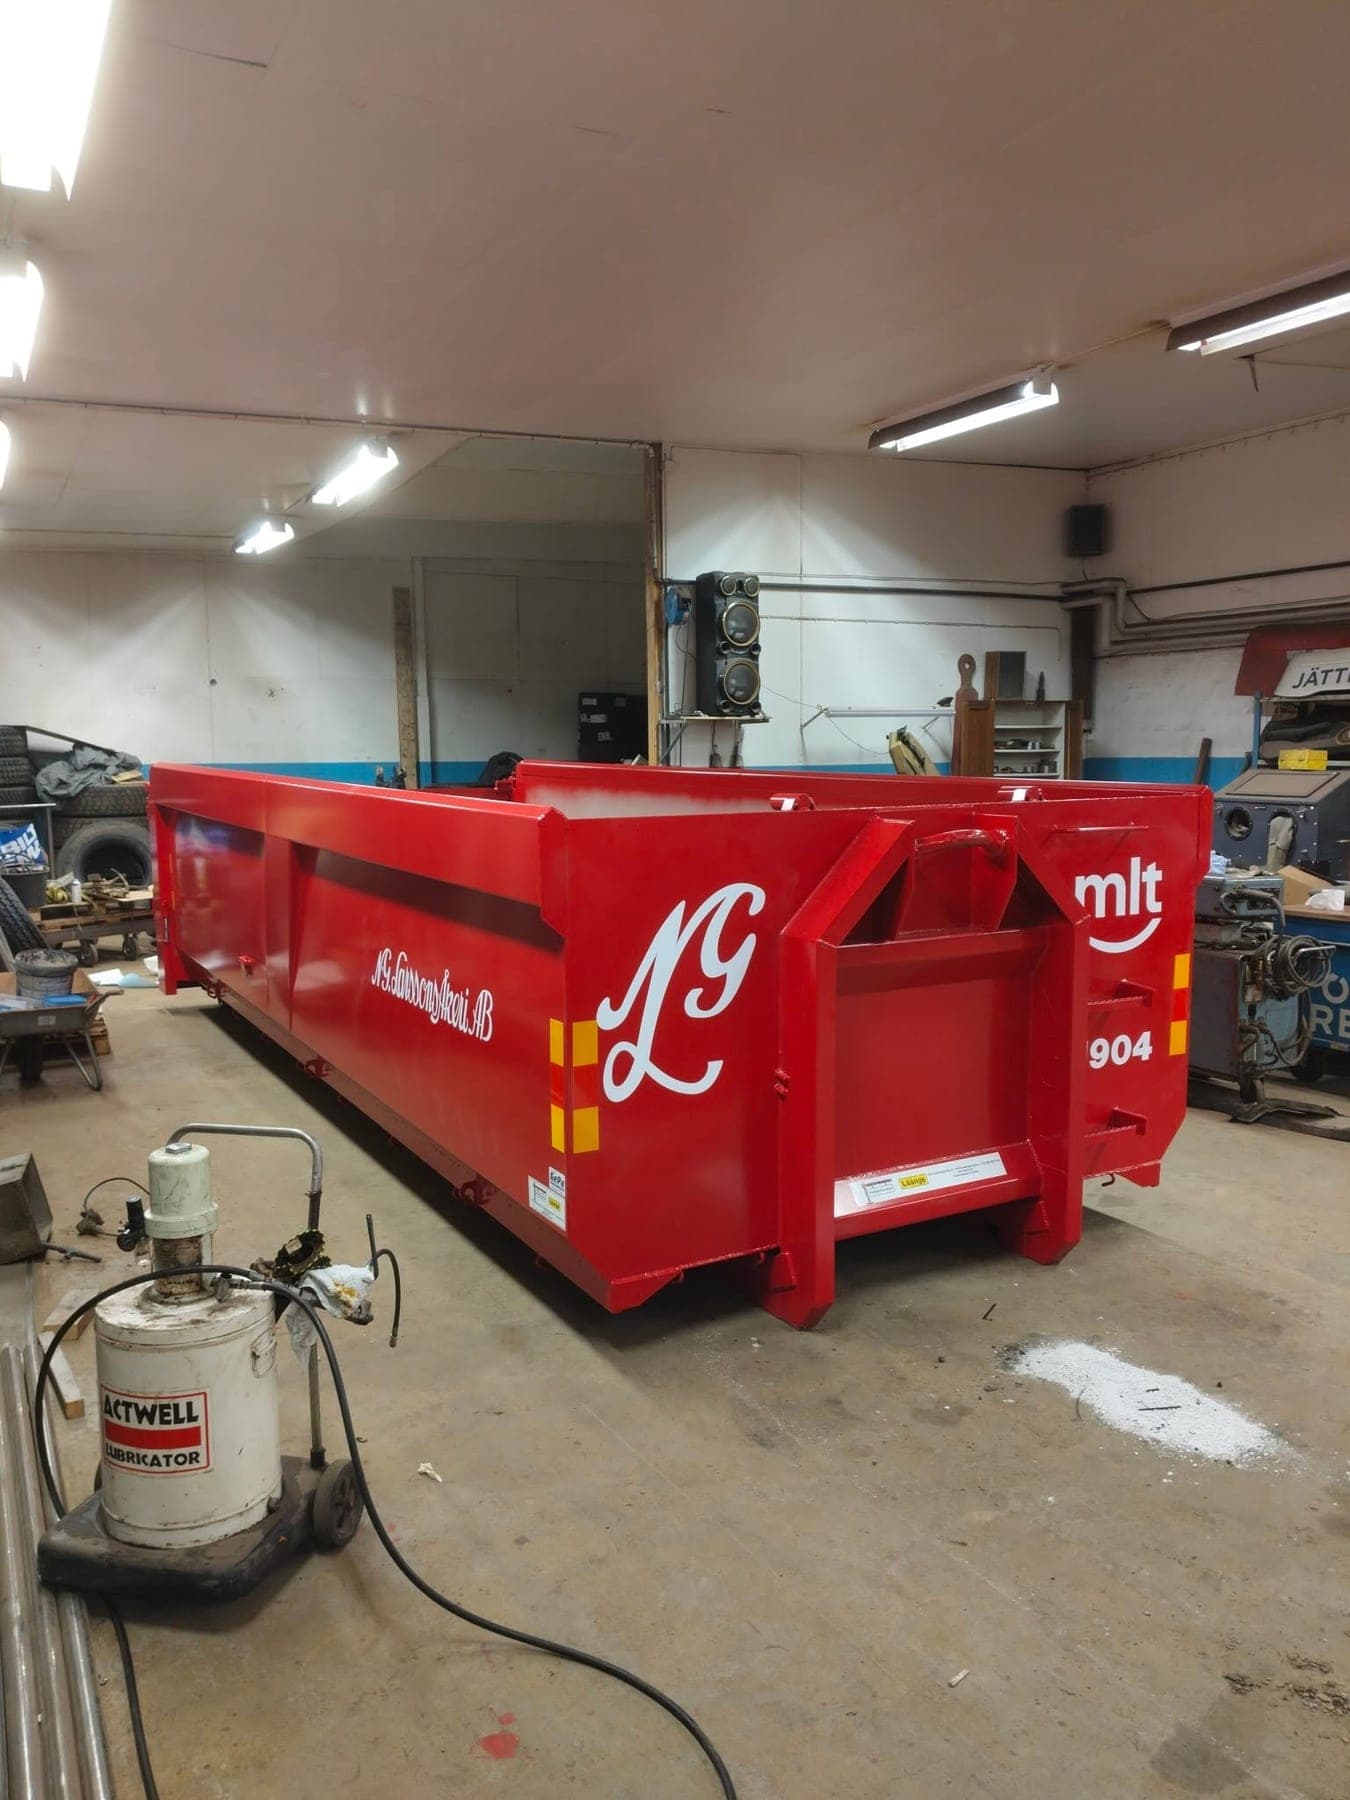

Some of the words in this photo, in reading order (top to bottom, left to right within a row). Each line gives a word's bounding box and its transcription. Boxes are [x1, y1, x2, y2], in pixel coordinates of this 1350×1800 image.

[1292, 666, 1350, 689] JÄTT
[1074, 856, 1163, 918] mlt
[103, 1394, 200, 1426] ACTWELL
[105, 1442, 201, 1468] LUBRICATOR
